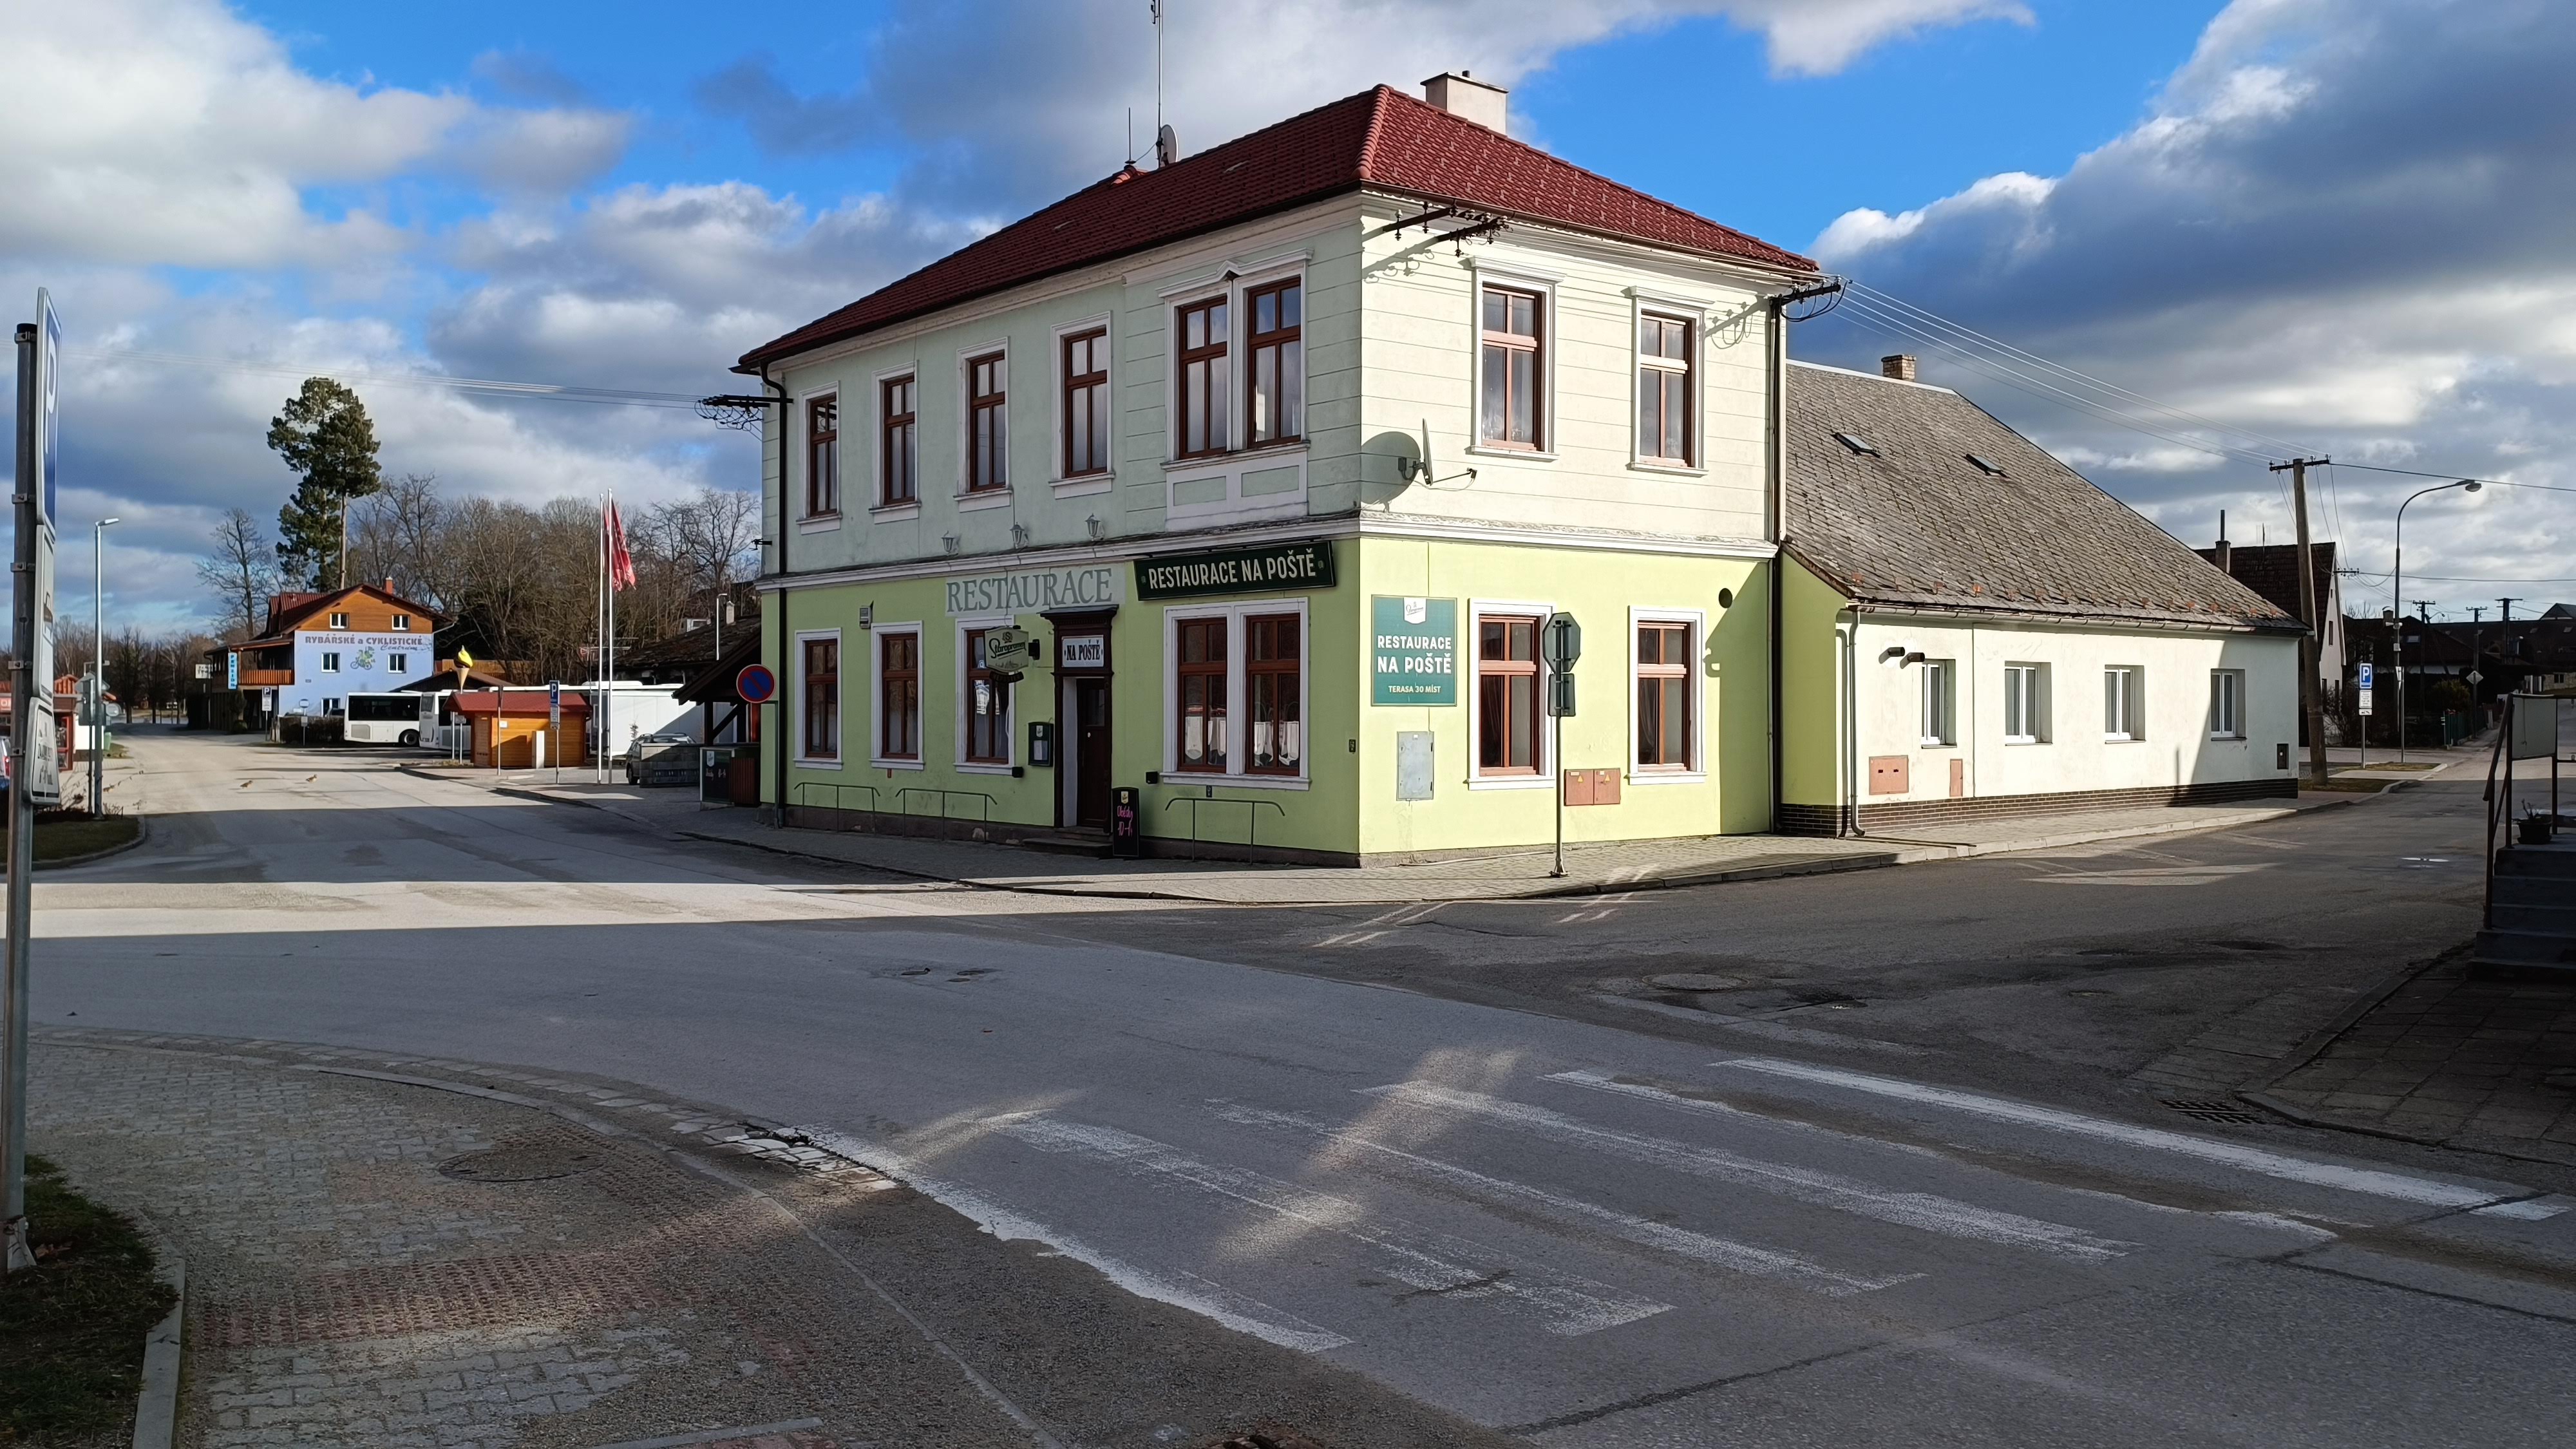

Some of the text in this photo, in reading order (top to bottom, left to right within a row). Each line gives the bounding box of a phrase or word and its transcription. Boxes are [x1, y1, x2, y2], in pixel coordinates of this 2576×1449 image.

[46, 328, 56, 454] P
[1148, 548, 1316, 589] RESTAURACE NA POŠTĚ
[946, 568, 1113, 612] RESTAURACE
[305, 634, 355, 644] RYBÁŘSKÉ
[366, 635, 422, 645] CYKLISTICKÉ
[1378, 635, 1452, 650] RESTAURACE
[1066, 639, 1100, 661] NA POŠTĚ
[1378, 652, 1452, 674] NA POŠTĚ
[2363, 667, 2370, 681] P
[552, 683, 557, 697] P
[1425, 685, 1441, 694] MÍST
